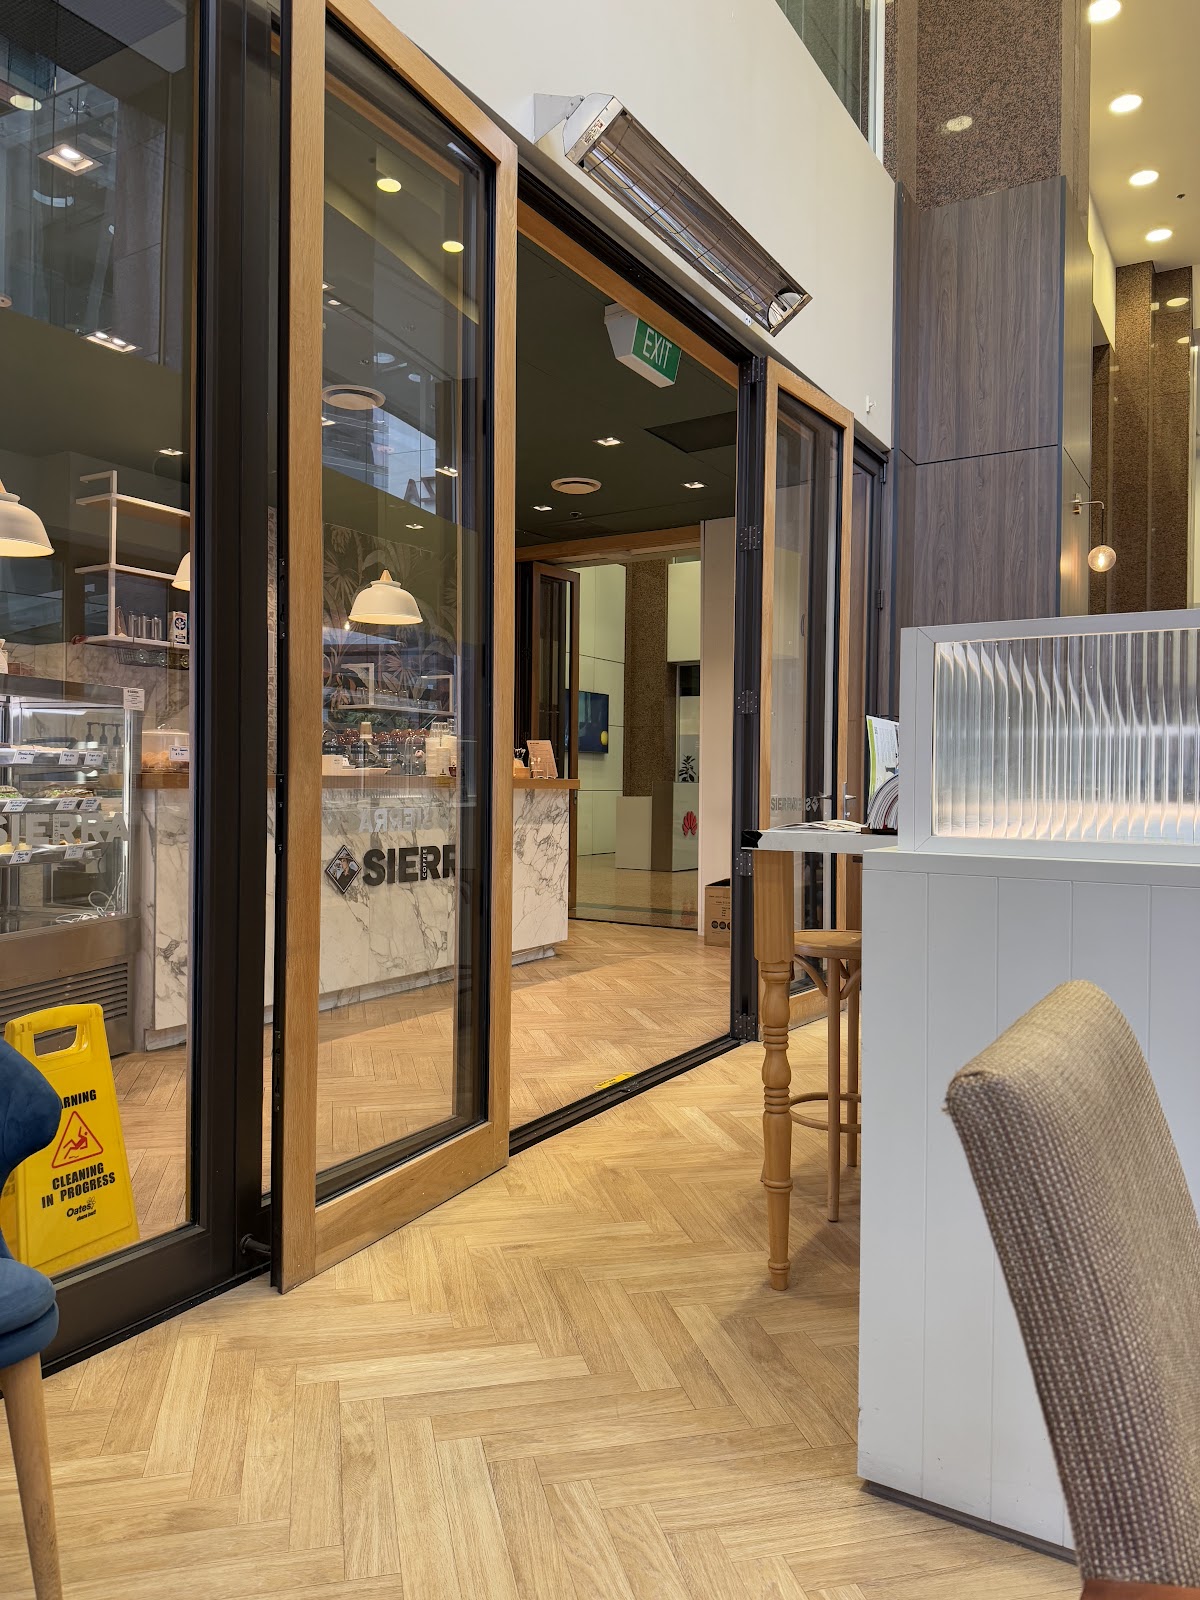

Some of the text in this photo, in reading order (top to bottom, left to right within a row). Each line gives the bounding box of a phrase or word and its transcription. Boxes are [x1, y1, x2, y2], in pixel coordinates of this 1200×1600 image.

[643, 327, 672, 369] EXIT
[62, 1089, 97, 1109] RNING
[52, 1162, 104, 1190] CLEANING
[41, 1172, 116, 1209] IN PROGRESS
[66, 1203, 92, 1218] Oates
